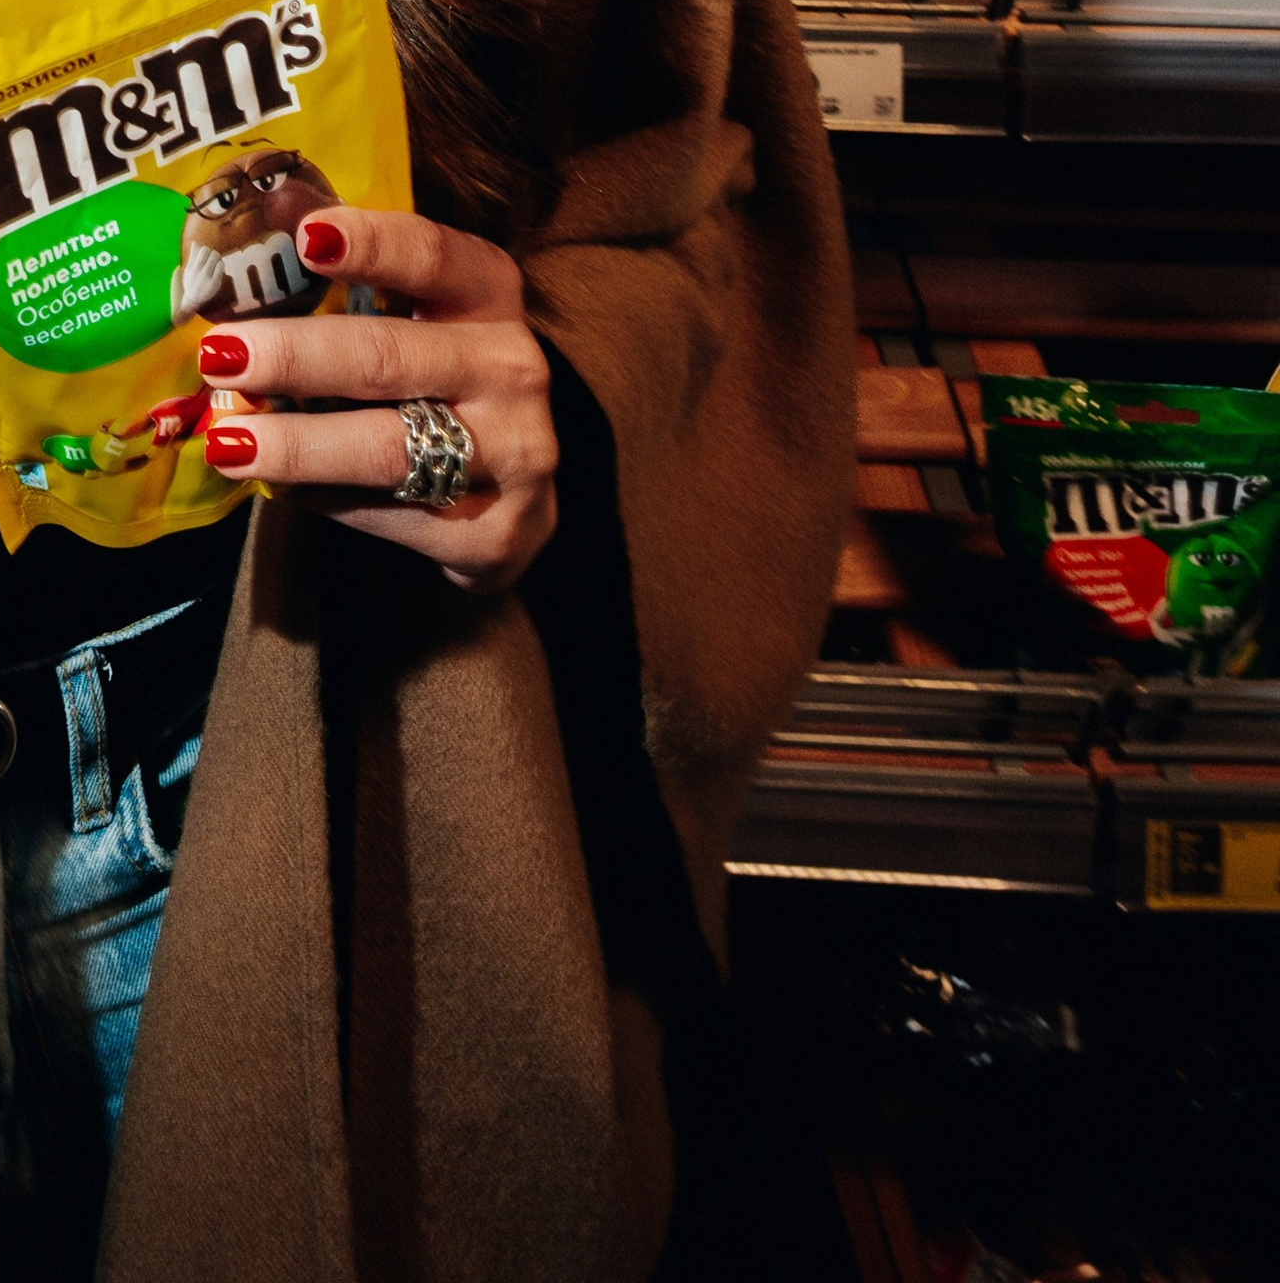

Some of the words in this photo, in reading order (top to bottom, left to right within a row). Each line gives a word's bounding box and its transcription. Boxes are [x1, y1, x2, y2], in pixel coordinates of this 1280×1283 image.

[6, 219, 120, 288] Делиться
[11, 250, 119, 307] полезно.
[17, 269, 132, 327] Особенно
[23, 285, 138, 347] весельем!
